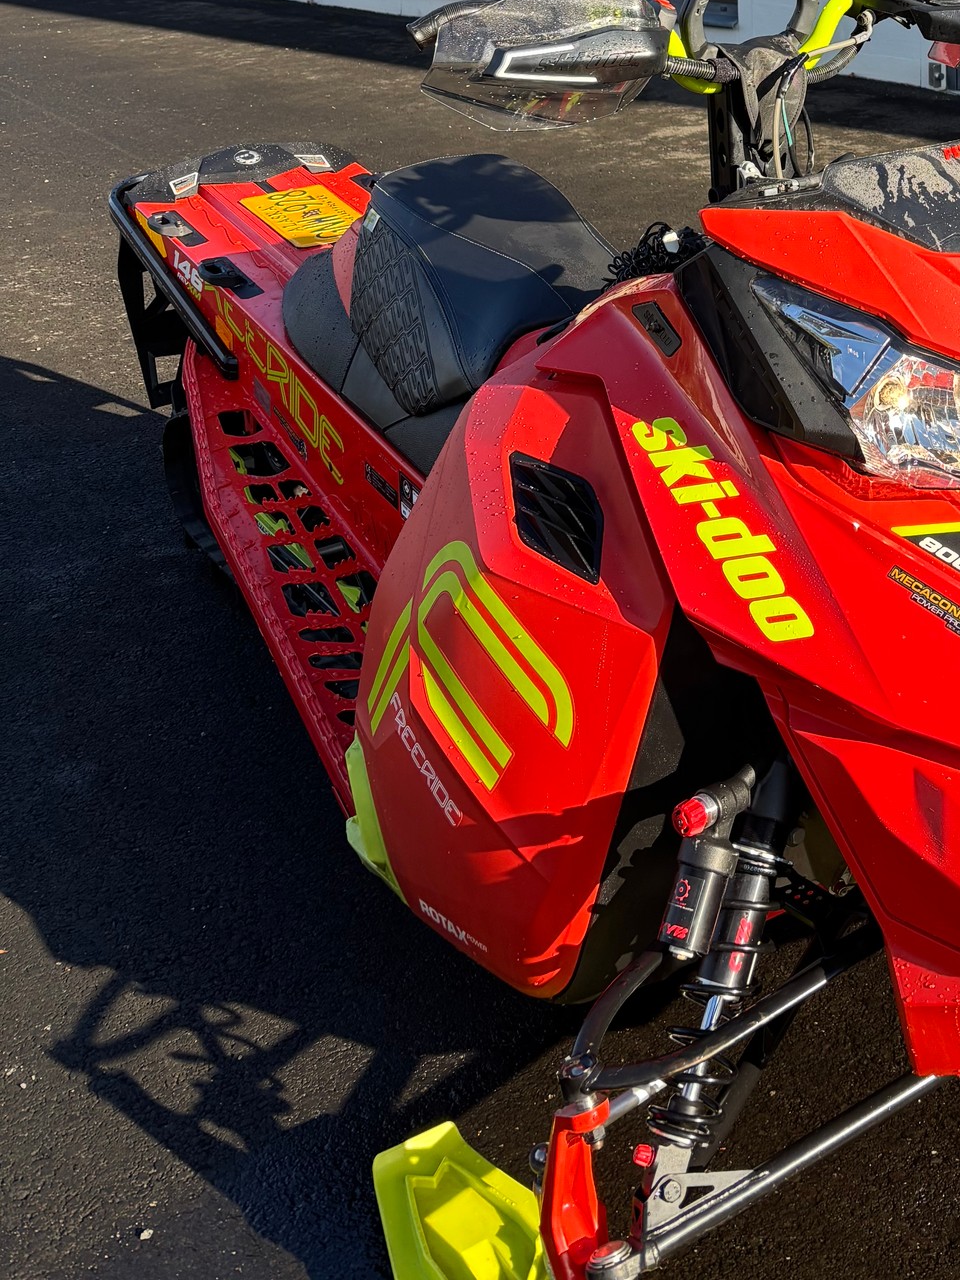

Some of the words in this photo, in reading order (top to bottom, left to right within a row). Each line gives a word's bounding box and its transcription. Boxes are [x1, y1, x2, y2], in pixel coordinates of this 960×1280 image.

[173, 249, 204, 293] 146
[631, 417, 815, 642] ski-doo
[911, 592, 945, 618] POWER
[389, 691, 464, 828] FREERIDE
[418, 897, 469, 946] ROTAX
[466, 932, 488, 953] POWER
